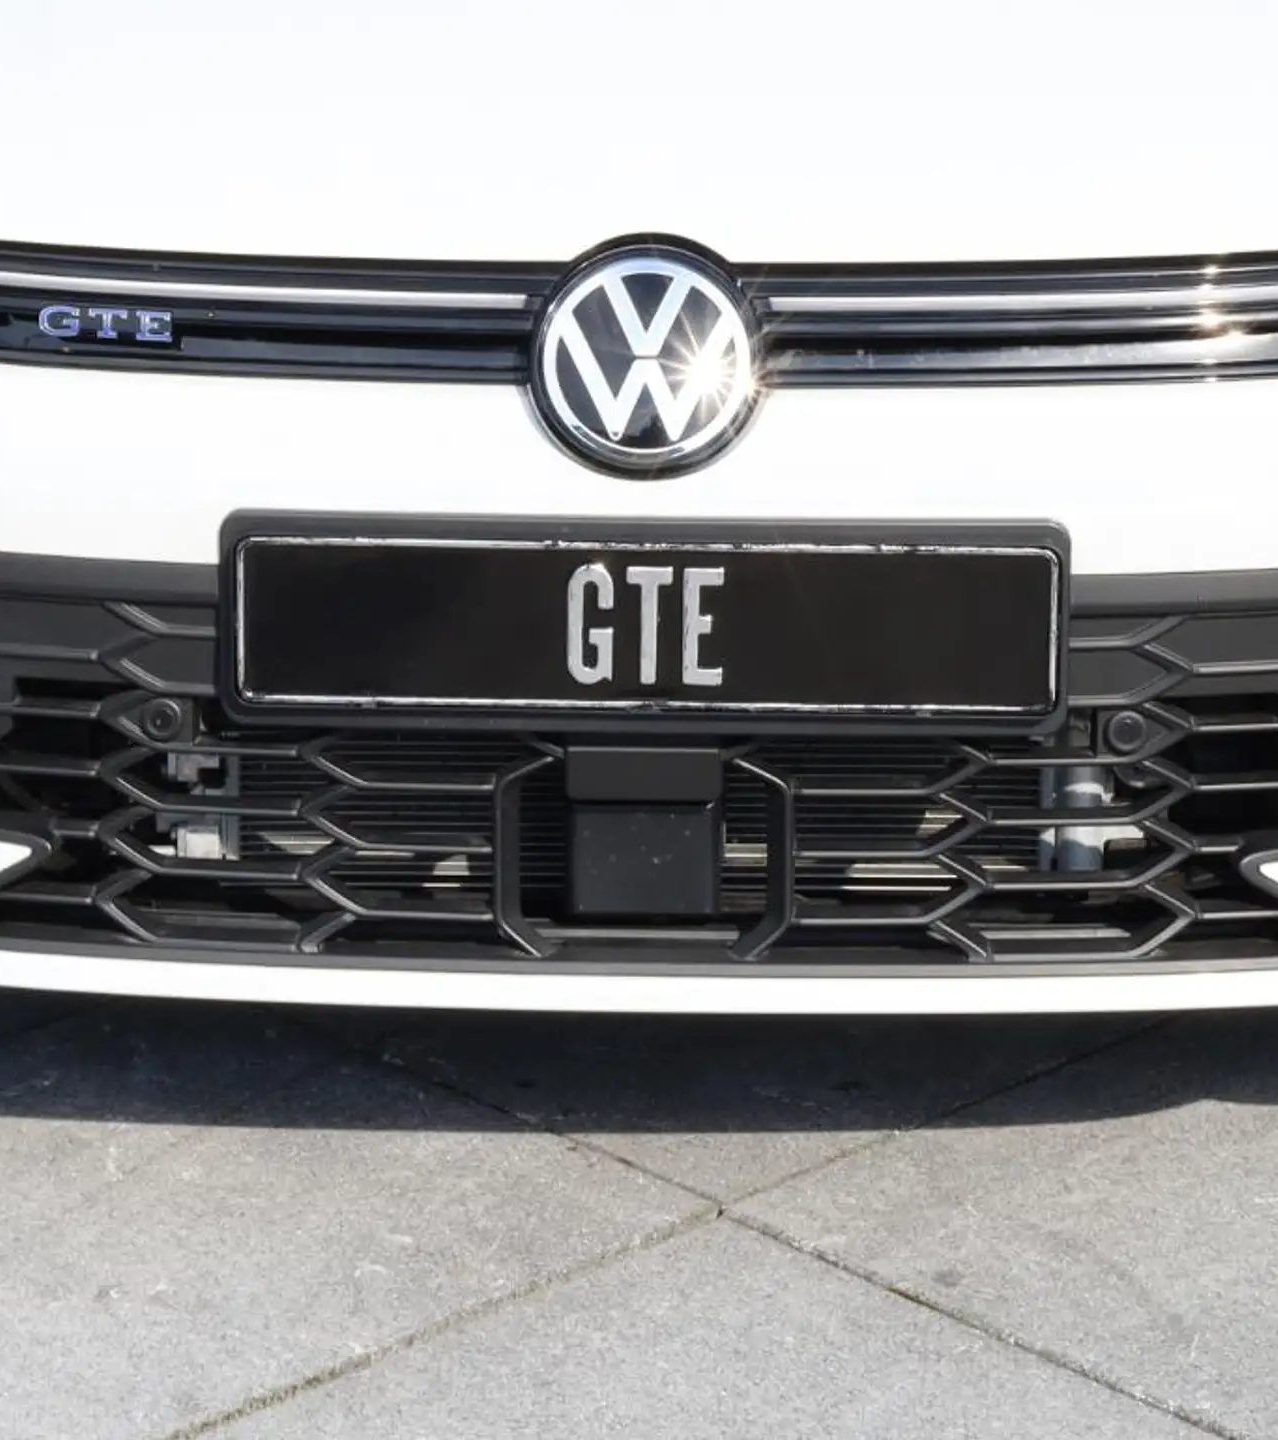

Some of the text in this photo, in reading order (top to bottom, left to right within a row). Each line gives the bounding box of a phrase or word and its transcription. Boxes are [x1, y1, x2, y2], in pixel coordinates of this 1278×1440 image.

[38, 305, 172, 342] GTE
[545, 258, 750, 450] VW
[567, 562, 725, 686] GTE
